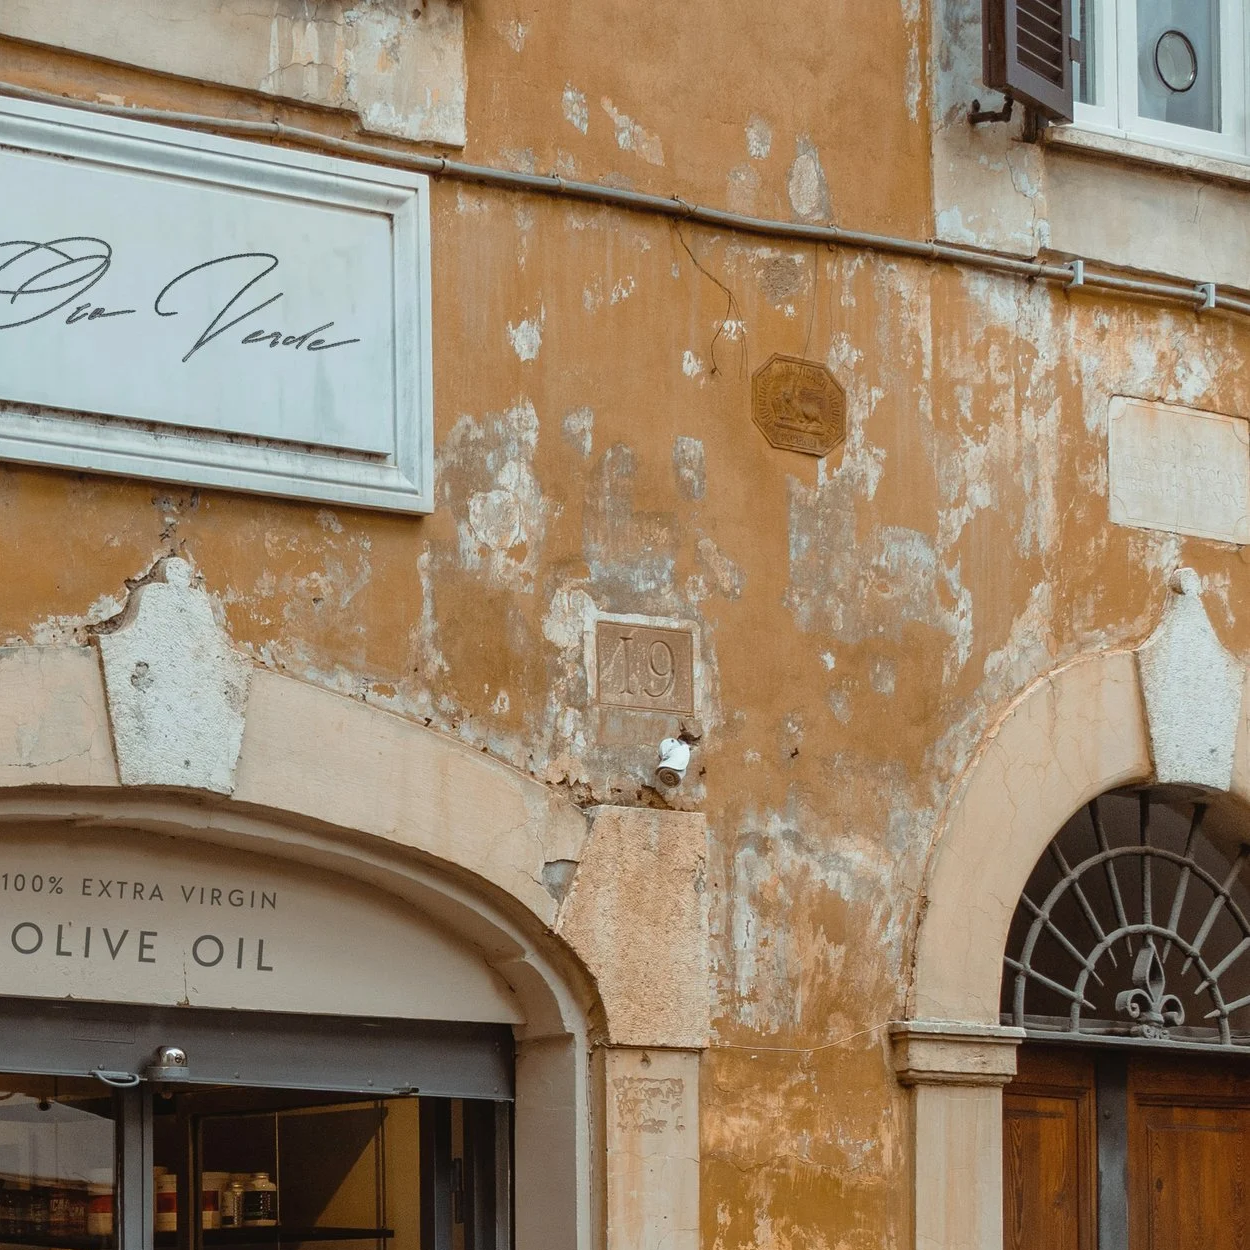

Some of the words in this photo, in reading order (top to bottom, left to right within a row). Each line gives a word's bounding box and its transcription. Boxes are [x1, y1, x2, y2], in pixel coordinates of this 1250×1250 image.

[155, 252, 361, 363] Verde
[618, 636, 676, 698] 19
[1, 872, 64, 895] 100%
[81, 877, 164, 902] EXTRA
[180, 884, 278, 910] VIRGIN
[11, 921, 159, 964] OLIVE
[192, 934, 274, 972] OIL
